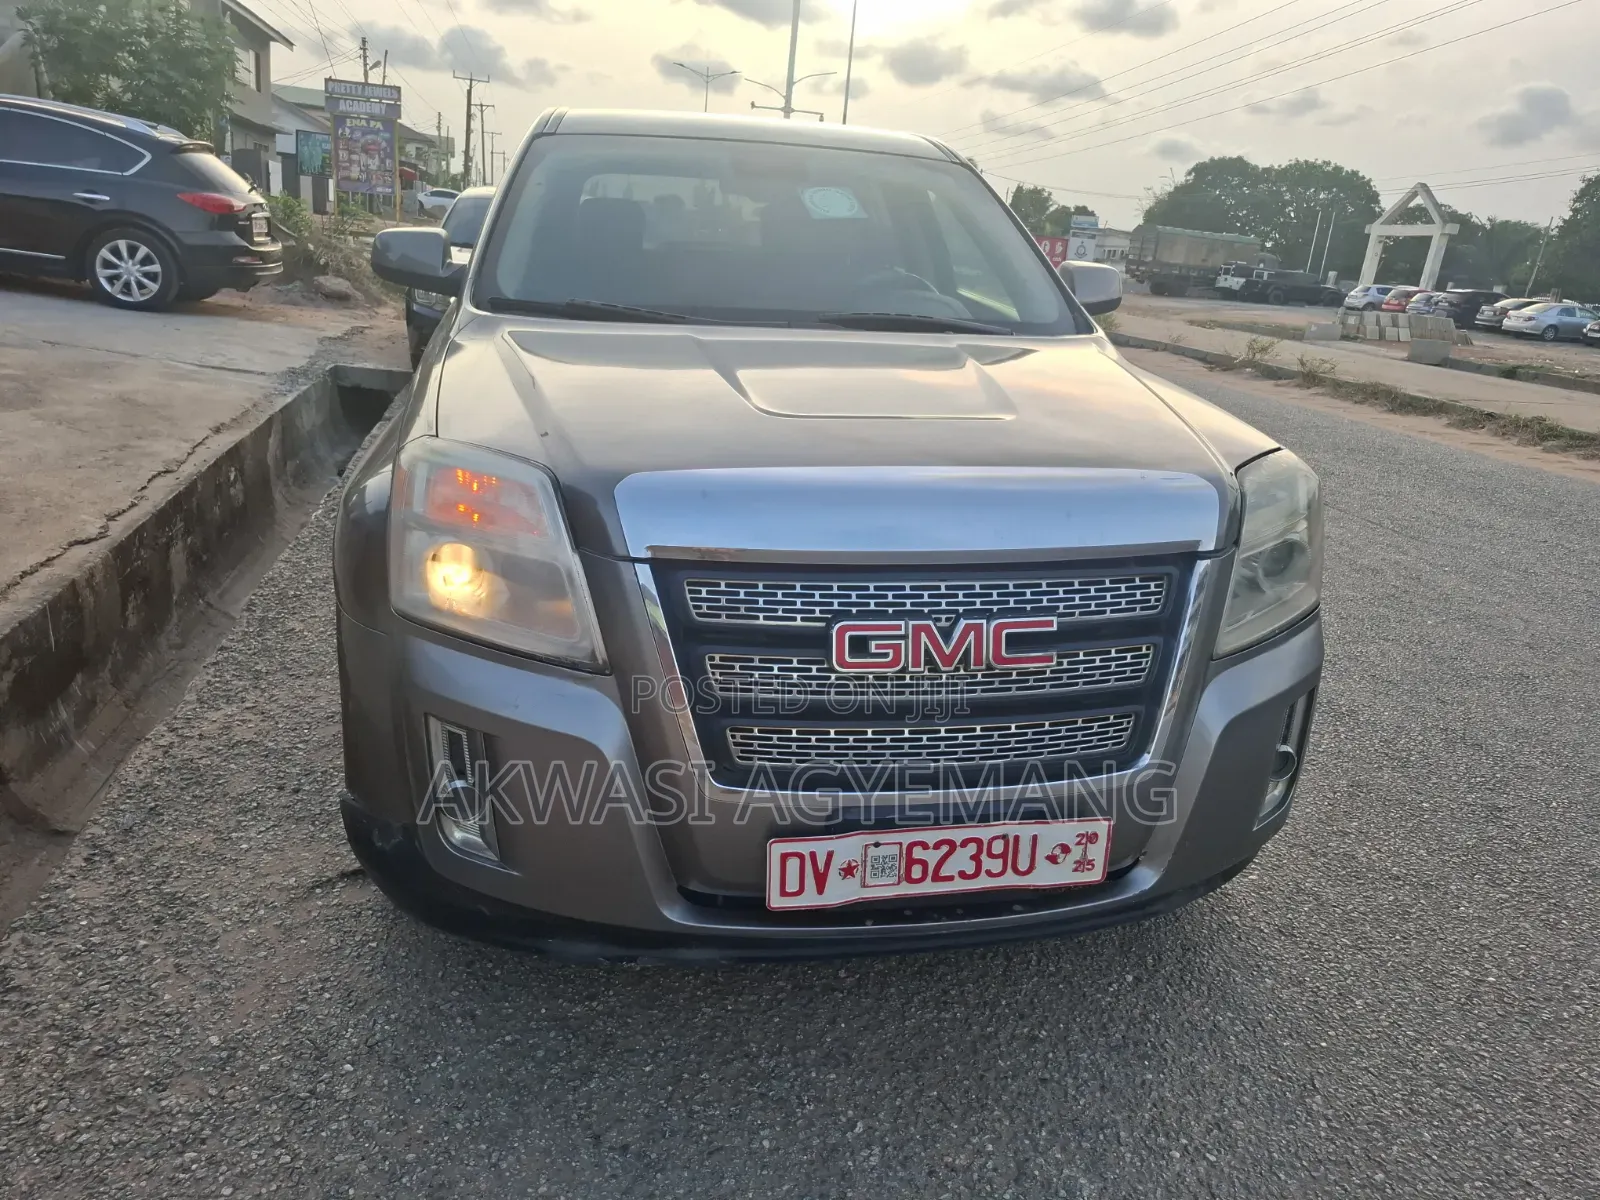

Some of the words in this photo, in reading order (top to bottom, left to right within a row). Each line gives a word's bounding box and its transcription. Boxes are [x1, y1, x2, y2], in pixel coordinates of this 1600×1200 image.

[328, 81, 362, 95] PRETTY
[339, 100, 386, 114] ACADEMY
[832, 616, 1058, 673] GMC
[779, 850, 836, 898] DV
[904, 833, 1039, 885] 6239U
